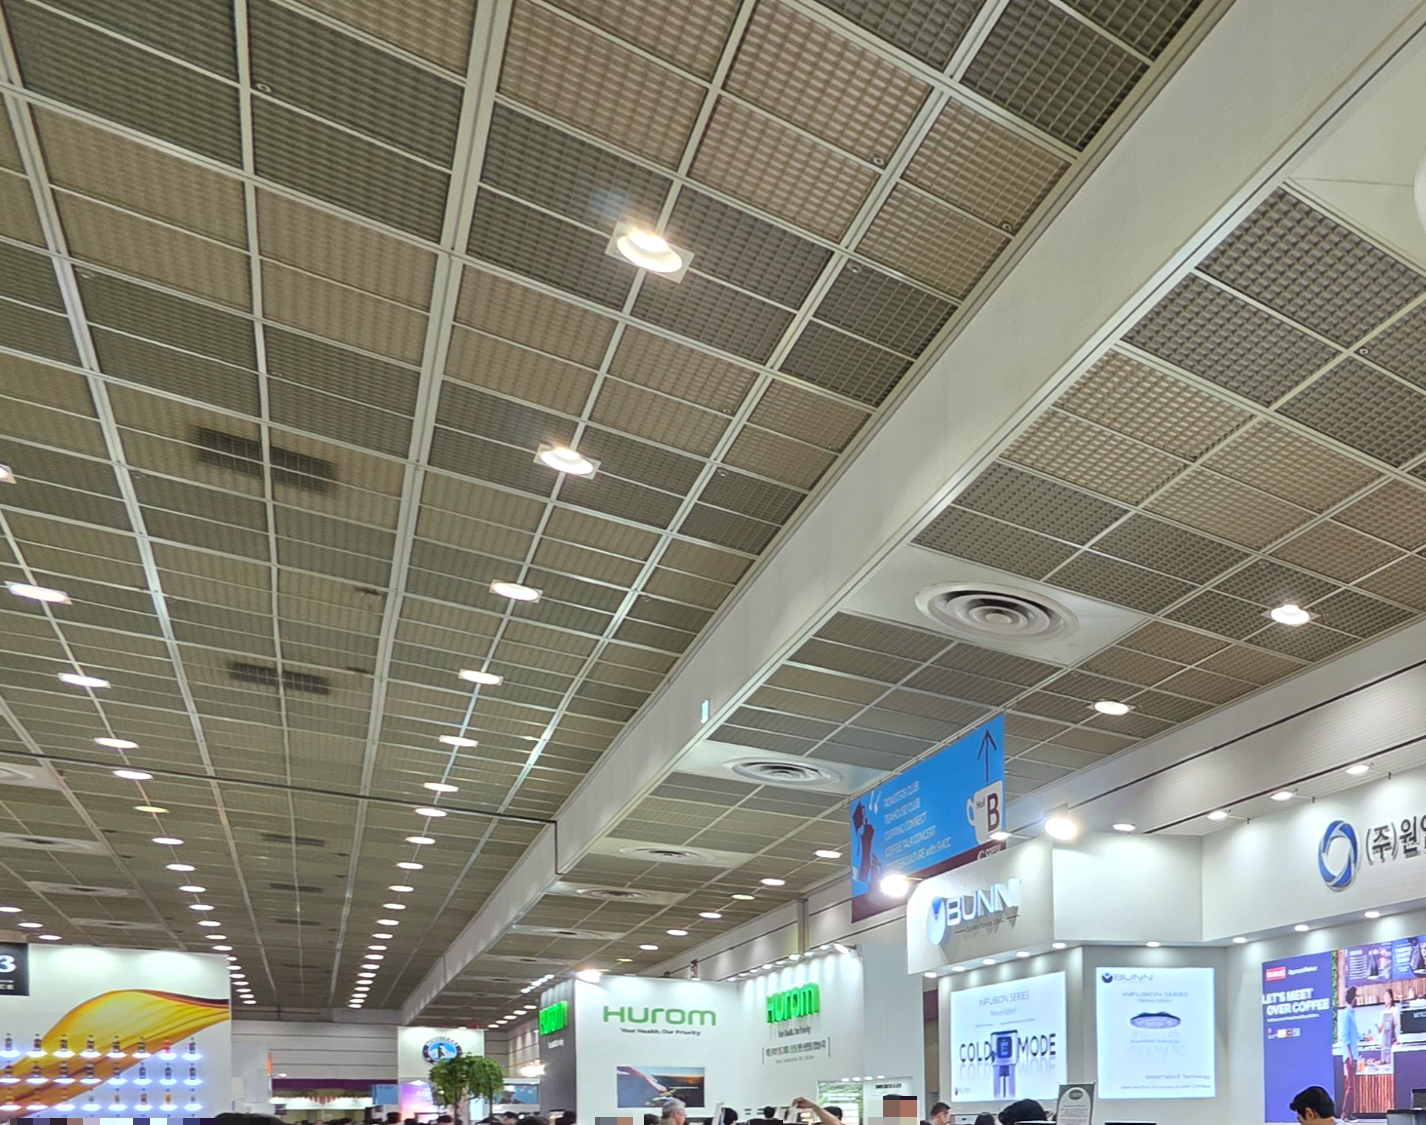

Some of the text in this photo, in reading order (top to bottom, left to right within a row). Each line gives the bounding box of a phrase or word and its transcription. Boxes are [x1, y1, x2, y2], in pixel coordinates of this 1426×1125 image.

[987, 793, 1000, 832] B
[946, 879, 1020, 926] BUNN
[767, 983, 820, 1023] Hurom
[1010, 990, 1030, 1002] SERIES
[1262, 988, 1314, 1004] LET'S MEET
[1267, 998, 1330, 1016] OVER COFFEE
[603, 1006, 717, 1026] Hurom
[959, 1033, 1057, 1063] COLD MODE
